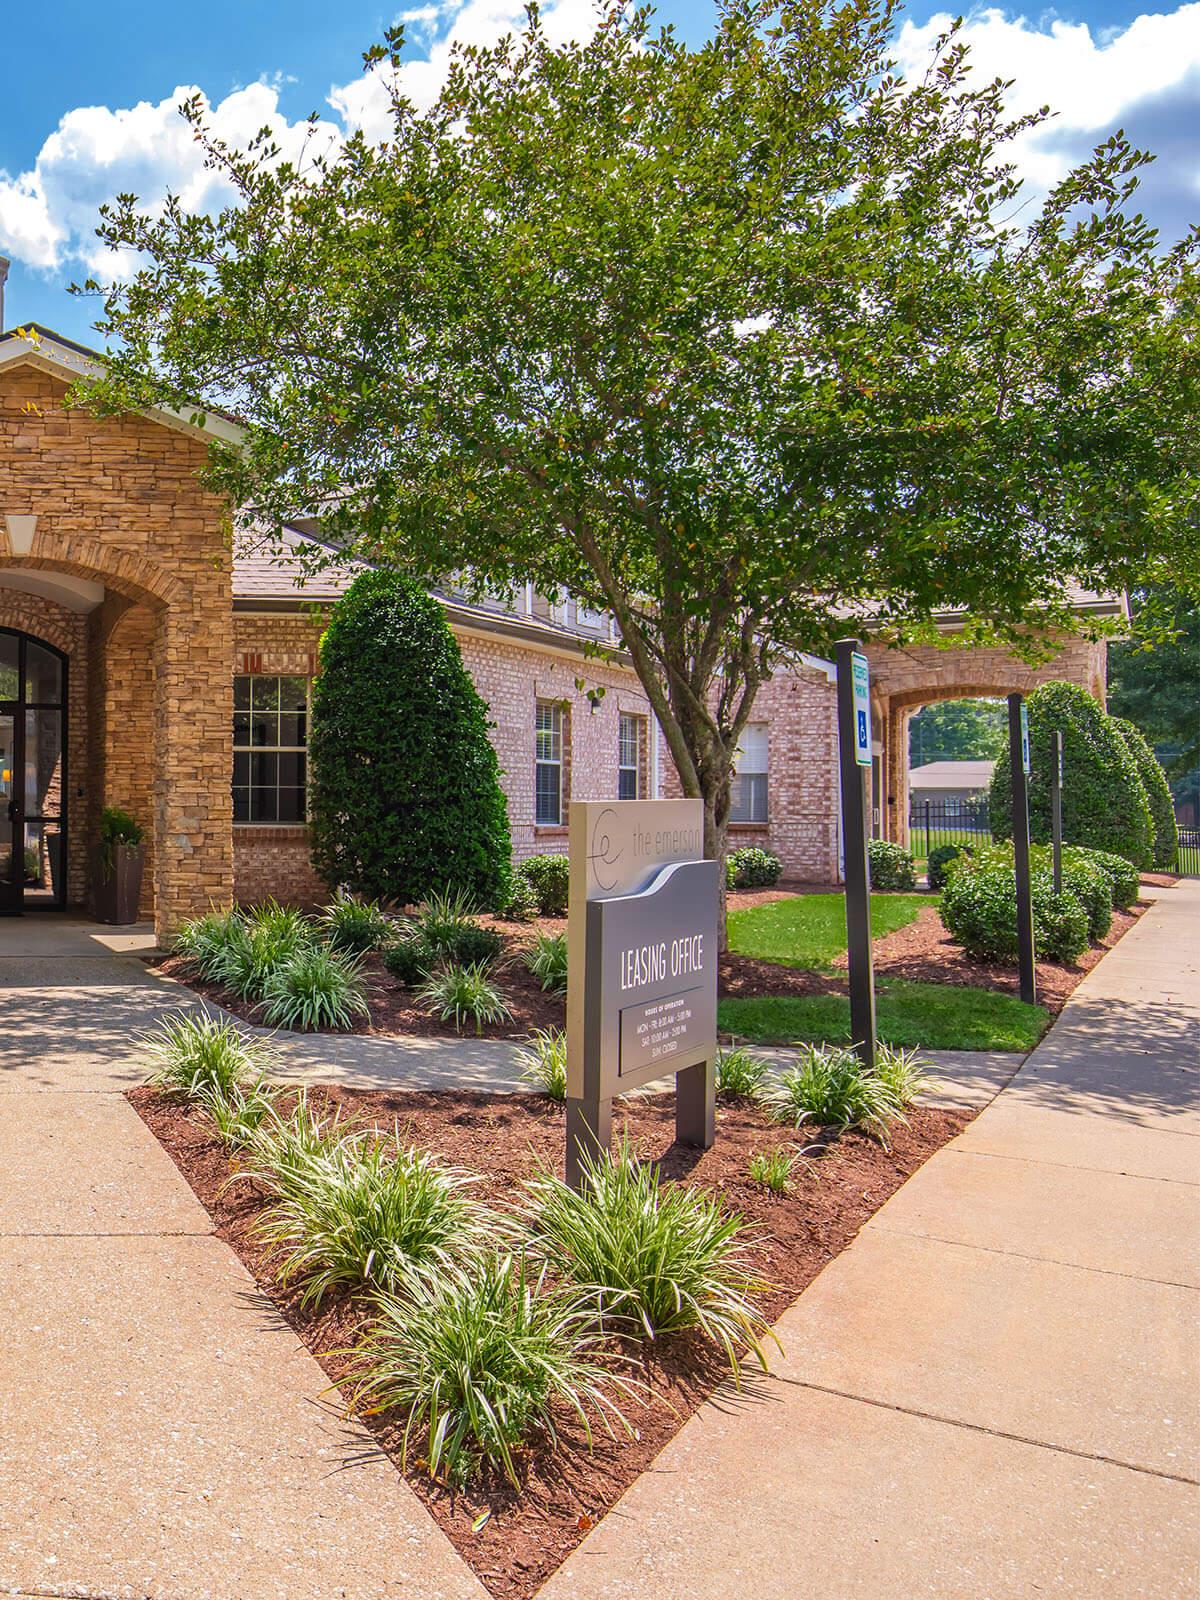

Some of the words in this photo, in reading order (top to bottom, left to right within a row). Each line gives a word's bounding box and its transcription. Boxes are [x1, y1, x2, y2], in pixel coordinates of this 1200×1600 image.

[633, 823, 651, 857] the
[655, 828, 700, 855] emerson
[621, 942, 666, 990] LEASING
[671, 934, 704, 977] OFFICE
